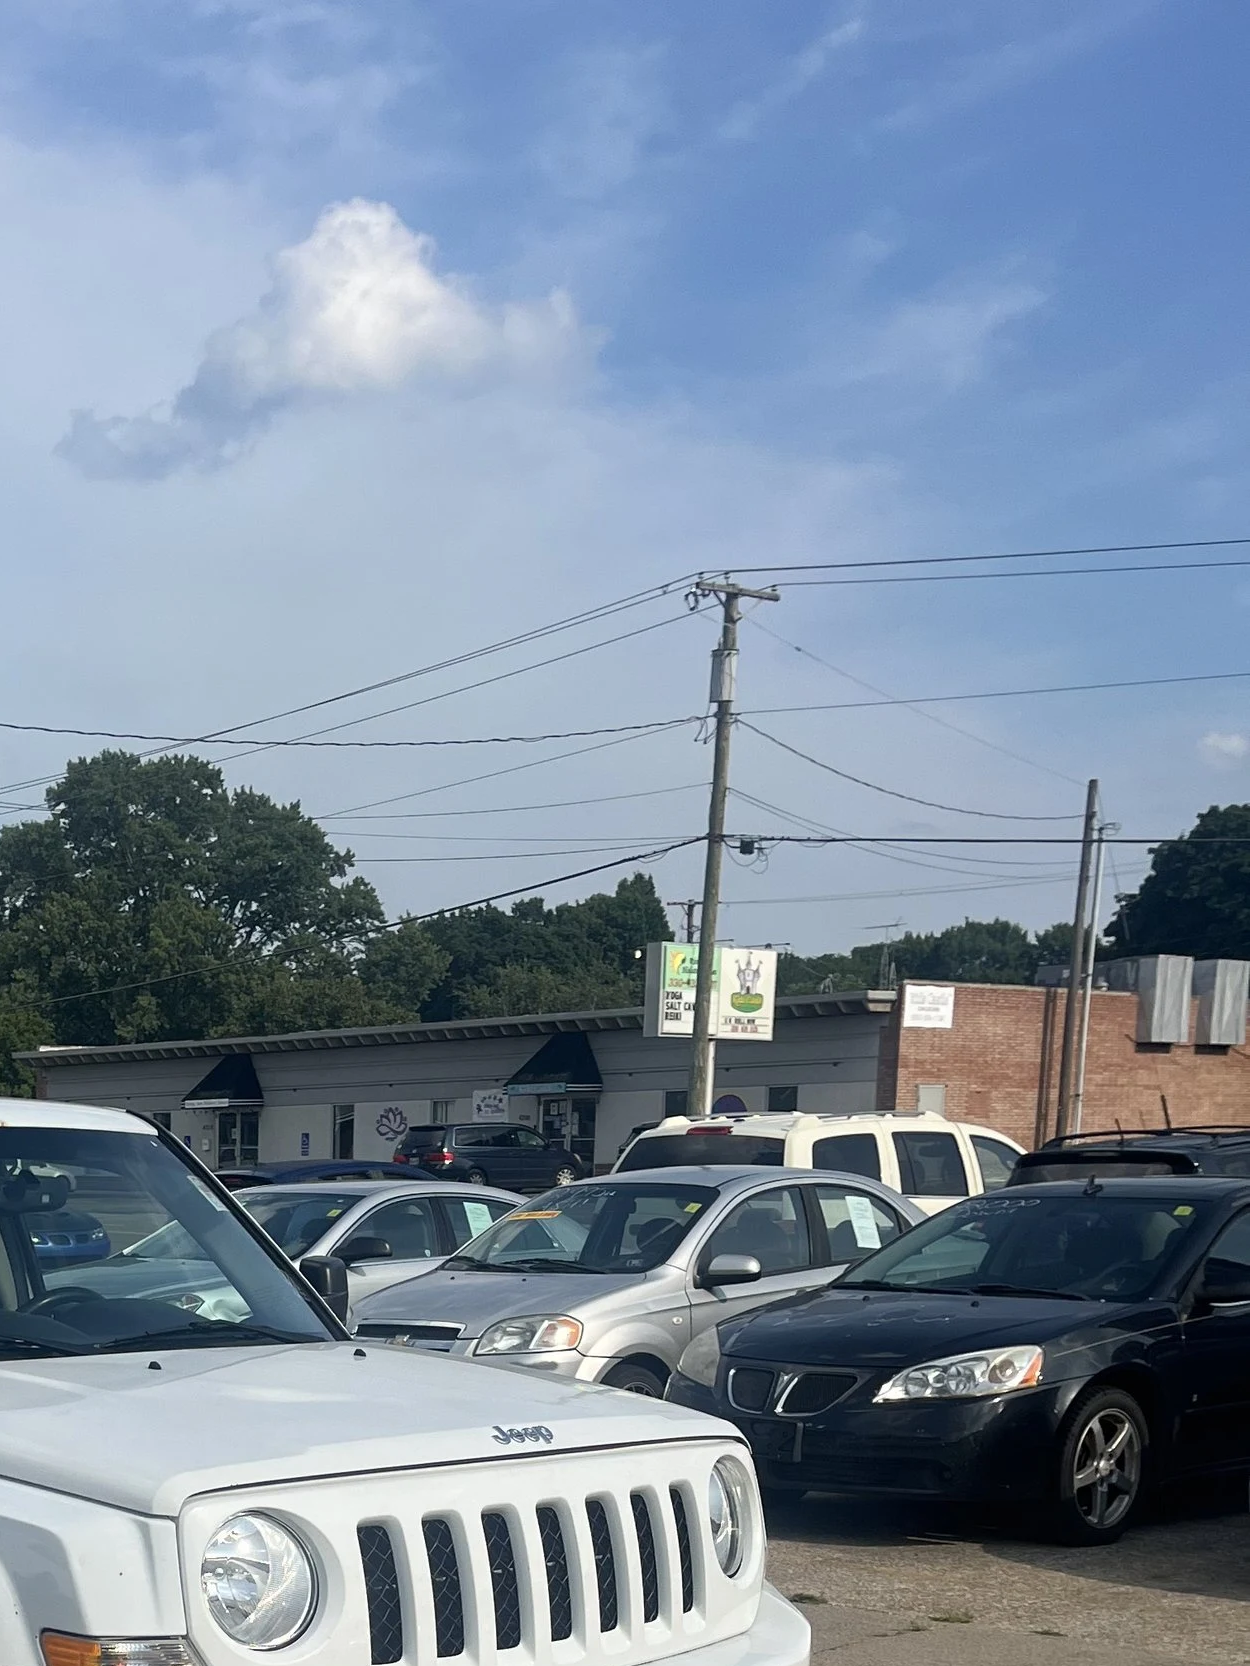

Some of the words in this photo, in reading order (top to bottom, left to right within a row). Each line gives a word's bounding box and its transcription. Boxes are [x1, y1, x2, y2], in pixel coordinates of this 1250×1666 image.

[665, 990, 683, 1000] YOGA
[665, 1001, 682, 1011] SALT
[490, 1425, 554, 1446] Jeep
